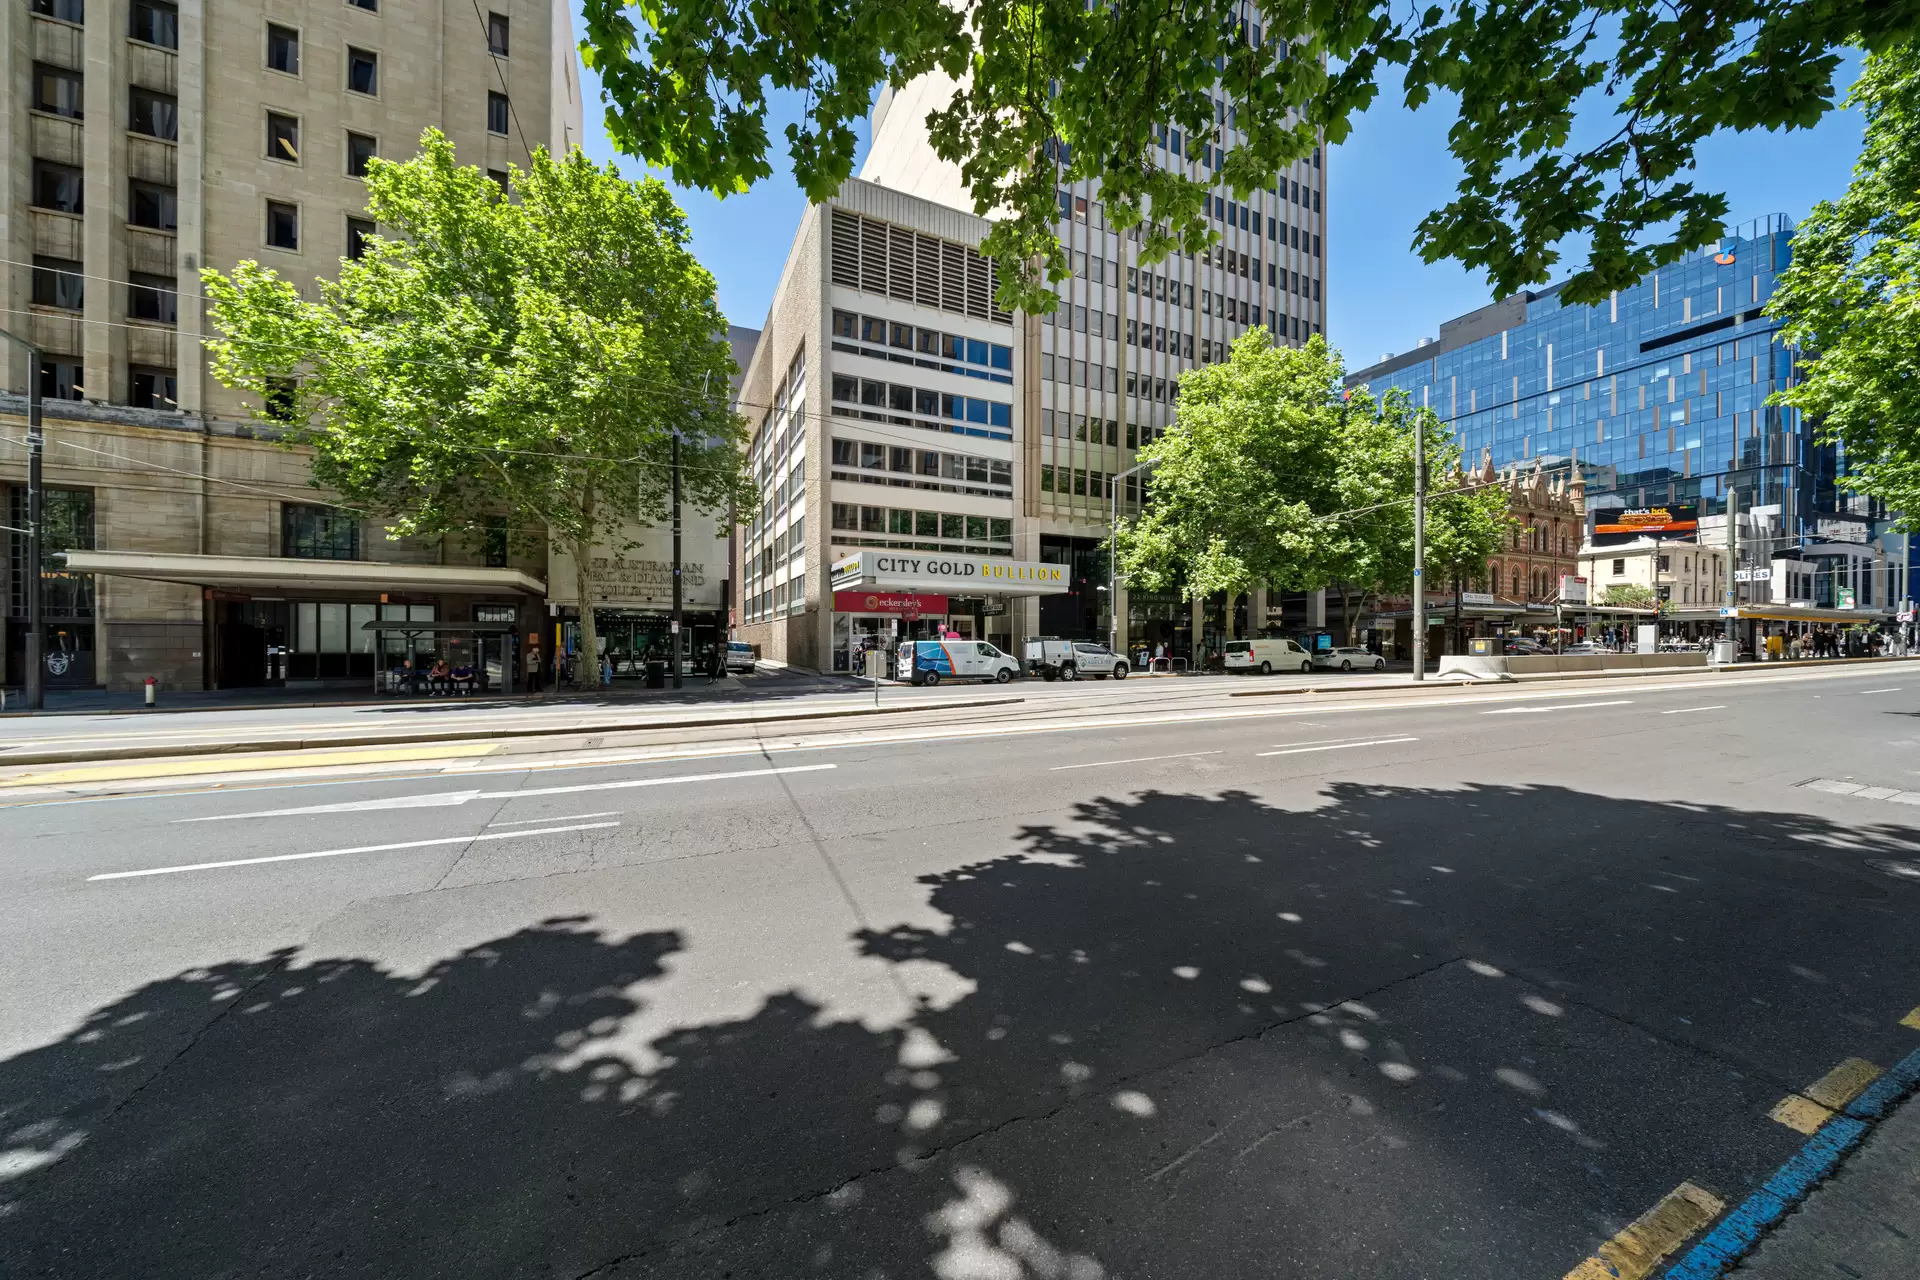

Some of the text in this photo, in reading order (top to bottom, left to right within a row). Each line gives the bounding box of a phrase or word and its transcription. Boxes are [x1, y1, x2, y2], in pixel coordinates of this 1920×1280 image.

[1623, 507, 1650, 515] that's
[611, 559, 704, 574] AUSTRAAN
[877, 558, 921, 573] CITY
[927, 561, 975, 577] GOLD
[981, 564, 1062, 581] BULLION
[590, 571, 706, 586] PAL & DIAMND
[1734, 571, 1768, 579] OLIES
[879, 597, 922, 609] eckersley's
